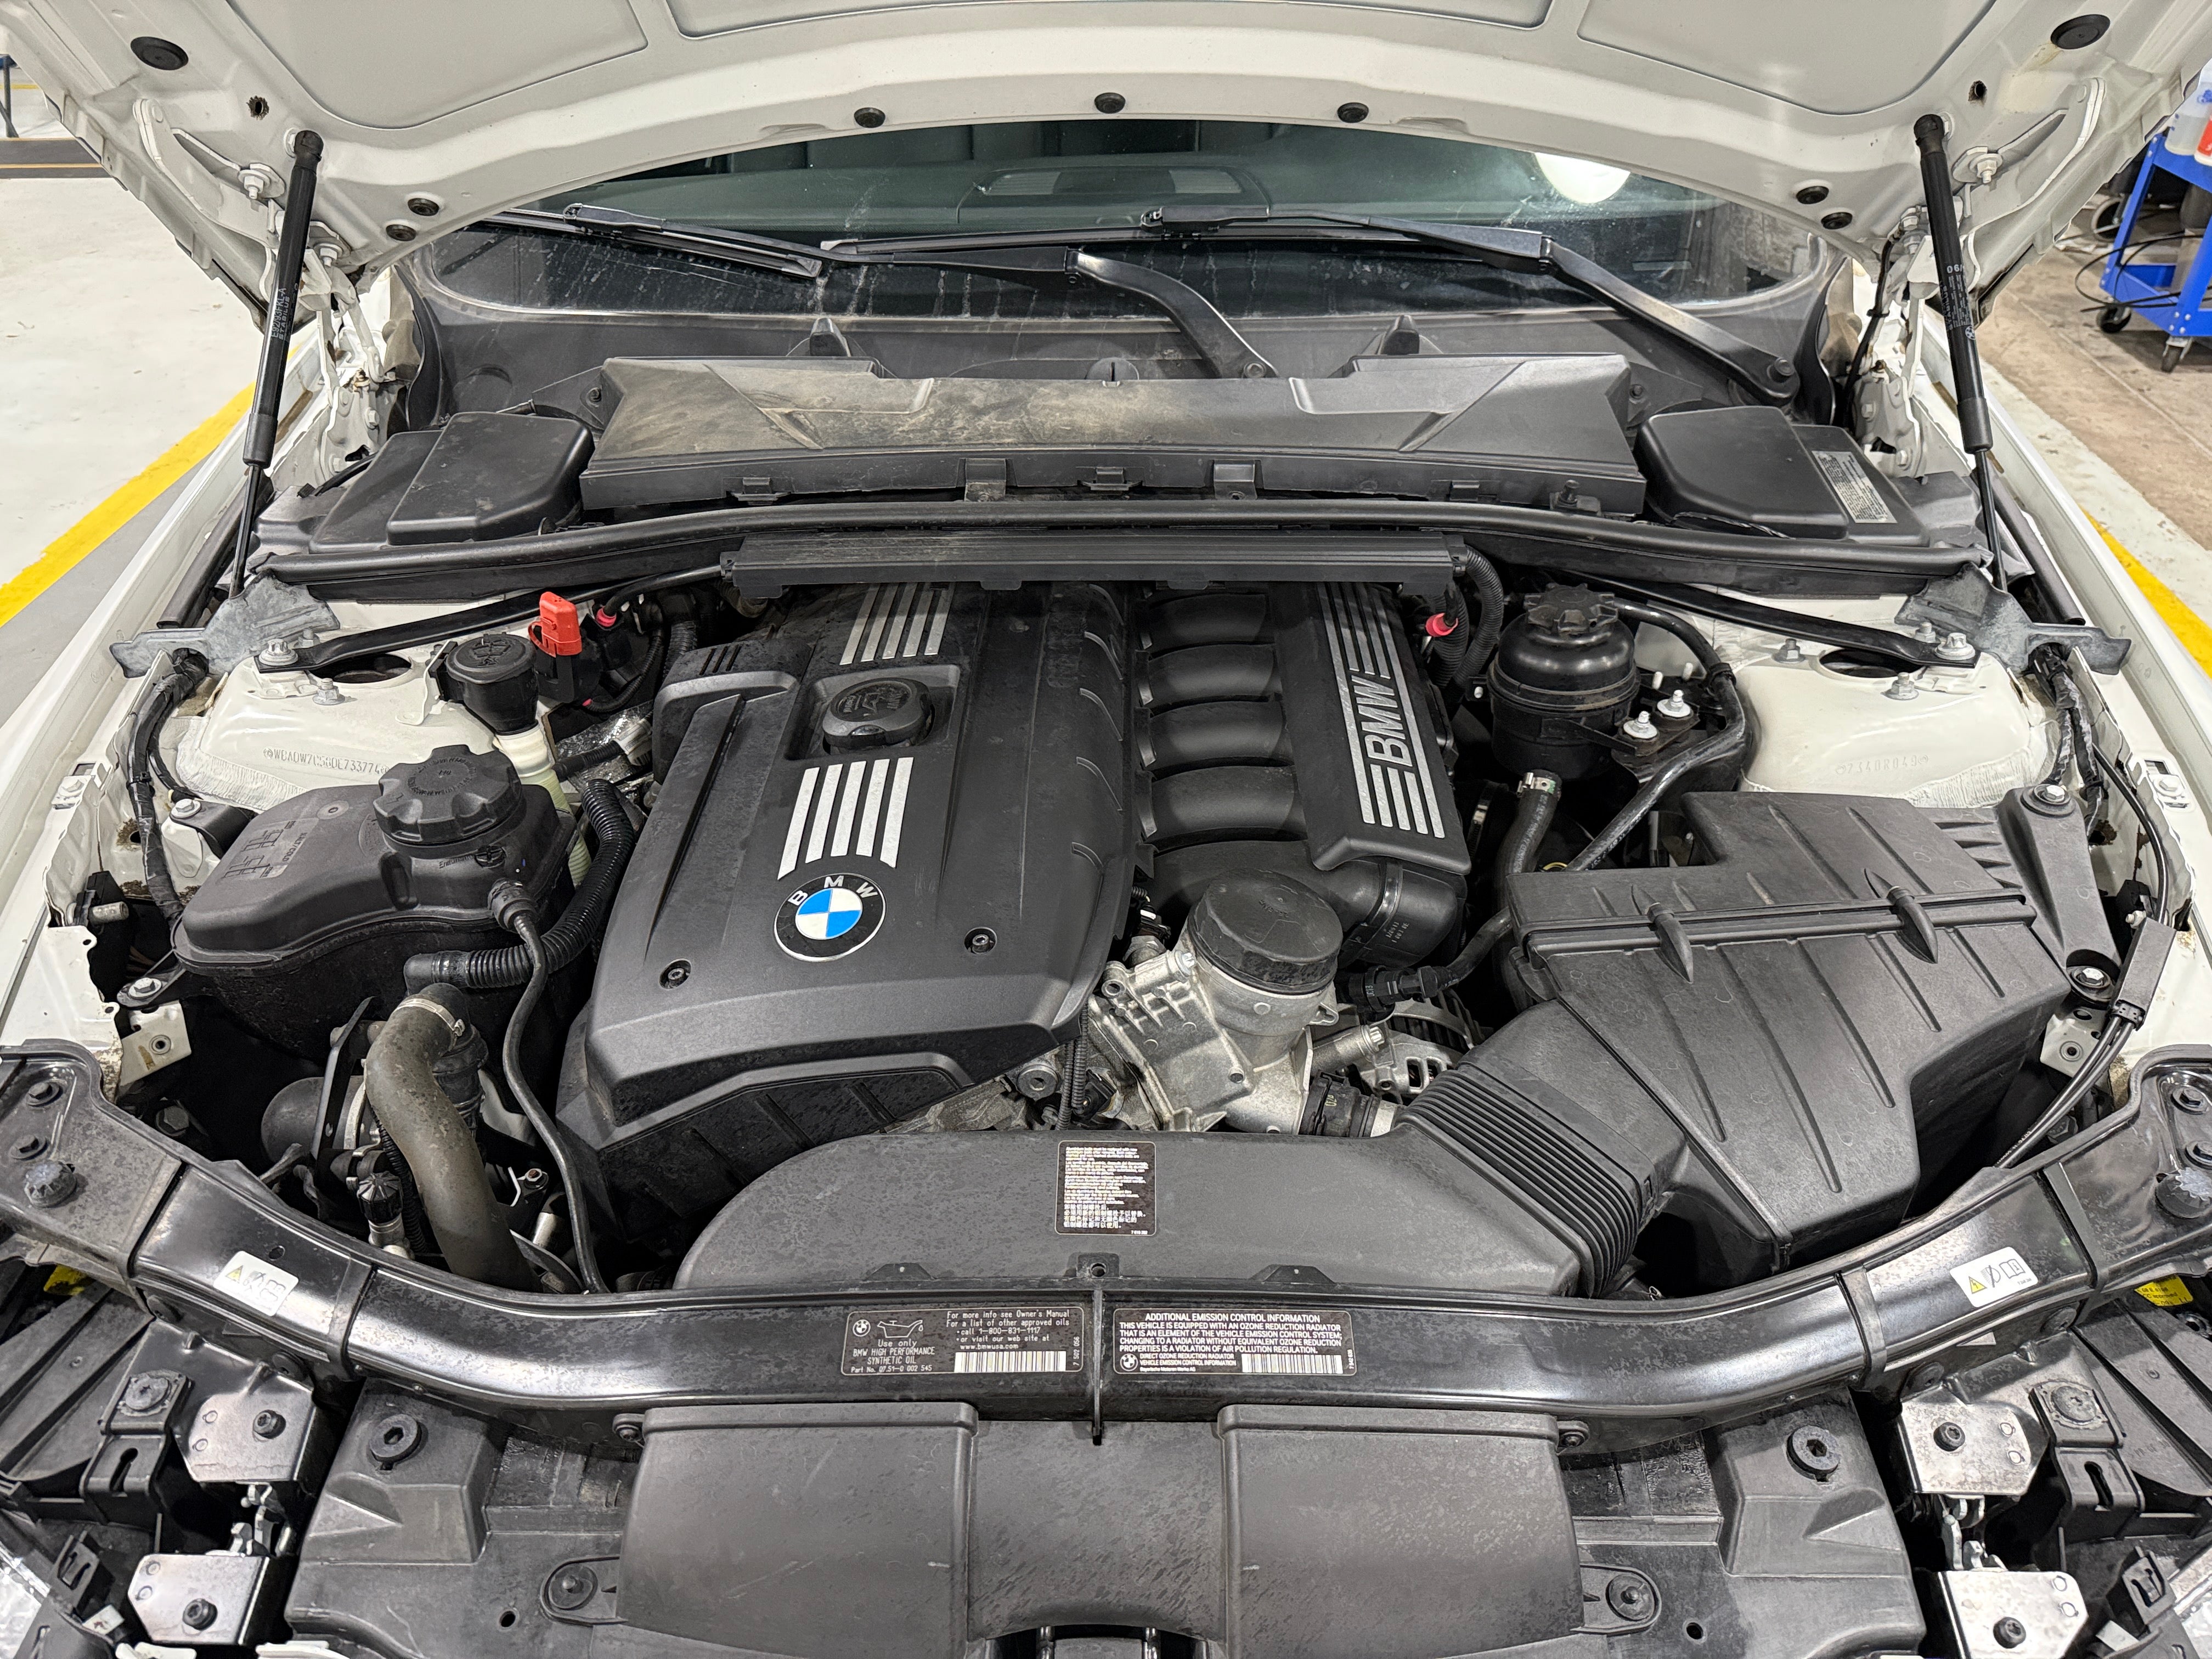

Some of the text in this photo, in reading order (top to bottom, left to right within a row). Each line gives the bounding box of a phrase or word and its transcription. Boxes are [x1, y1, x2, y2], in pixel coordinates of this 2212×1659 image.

[279, 296, 290, 340] STABILUS
[1351, 674, 1413, 768] BMW
[788, 874, 876, 906] BMW
[946, 1311, 958, 1319] For
[983, 1310, 997, 1319] info
[1015, 1309, 1042, 1317] Owner's
[1046, 1309, 1069, 1318] Manual
[1145, 1313, 1321, 1323] ADDITIONAL EMISSION CONTROL INFORMATION
[945, 1319, 958, 1327] For
[969, 1318, 983, 1327] list
[986, 1318, 995, 1328] of
[998, 1318, 1017, 1328] other
[1020, 1318, 1052, 1328] approved
[1166, 1322, 1173, 1330] IS
[1174, 1322, 1209, 1330] EQUIPPED
[1228, 1323, 1239, 1331] AN
[1239, 1323, 1264, 1331] OZONE
[1265, 1323, 1305, 1331] REDUCTION
[1146, 1330, 1157, 1338] AN
[1158, 1330, 1189, 1338] ELEMENT
[1216, 1330, 1244, 1339] VEHICLE
[1279, 1331, 1312, 1339] CONTROL
[877, 1338, 917, 1348] Use only
[1166, 1338, 1172, 1346] A
[1172, 1338, 1205, 1346] RADIATOR
[1238, 1338, 1278, 1346] EQUIVALENT
[1304, 1339, 1342, 1347] REDUCTION
[853, 1346, 935, 1357] BMW HIGH PERFORMANCE
[1175, 1345, 1211, 1353] VIOLATION
[1212, 1345, 1221, 1353] OF
[1222, 1345, 1234, 1353] AIR
[866, 1355, 917, 1365] SYNTHETIC OIL
